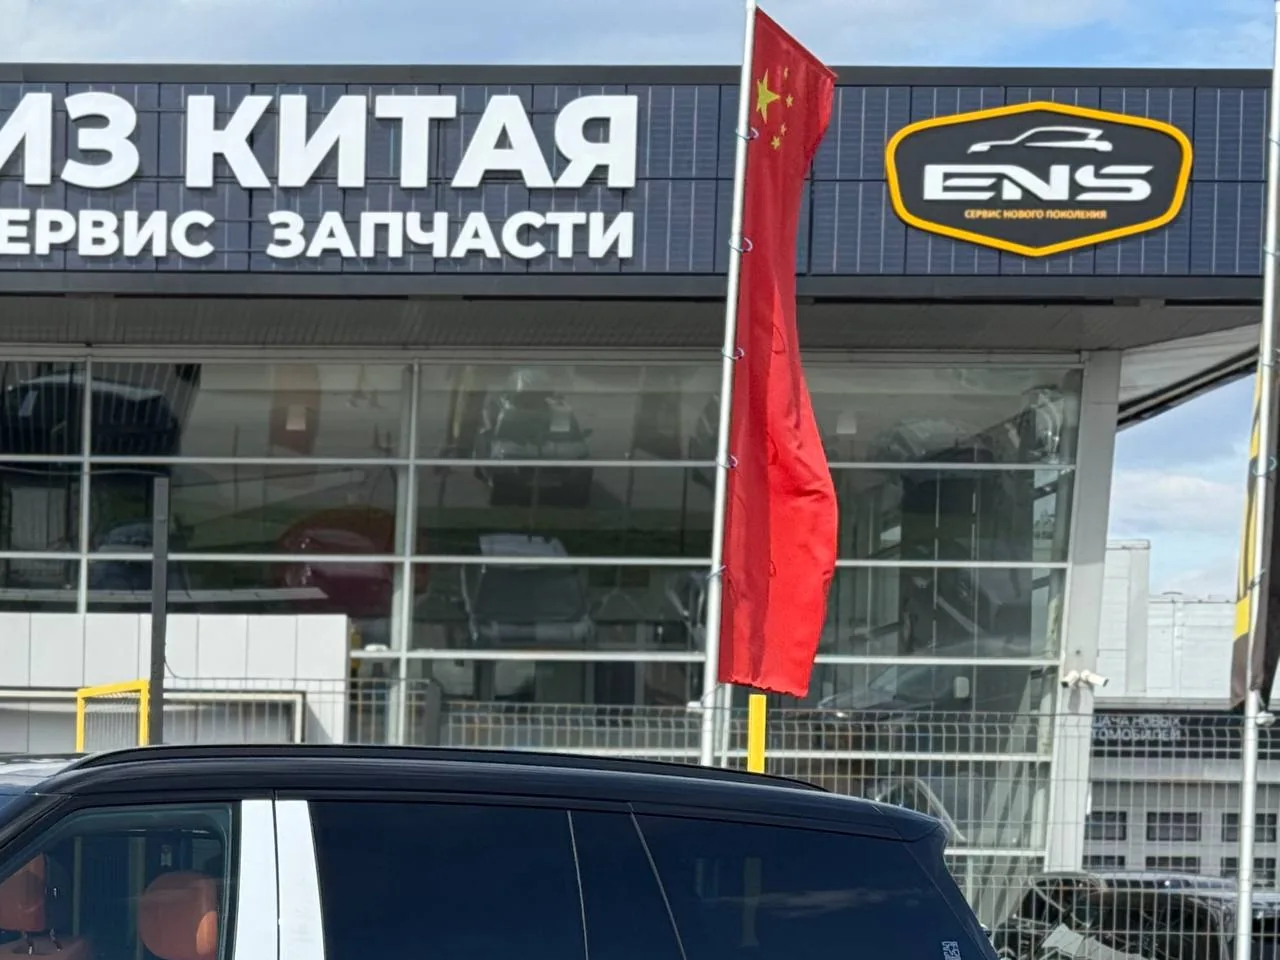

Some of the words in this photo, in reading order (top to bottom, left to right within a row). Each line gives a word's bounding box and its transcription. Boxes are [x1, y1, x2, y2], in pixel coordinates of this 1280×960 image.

[185, 94, 639, 190] КИТАЯ
[923, 164, 1154, 201] ENS
[266, 210, 634, 262] ЗАПЧАСТИ
[964, 209, 1002, 219] СЕРВИС
[1003, 209, 1044, 219] НОВОГО
[1045, 209, 1108, 220] ПОКОЛЕНИЯ
